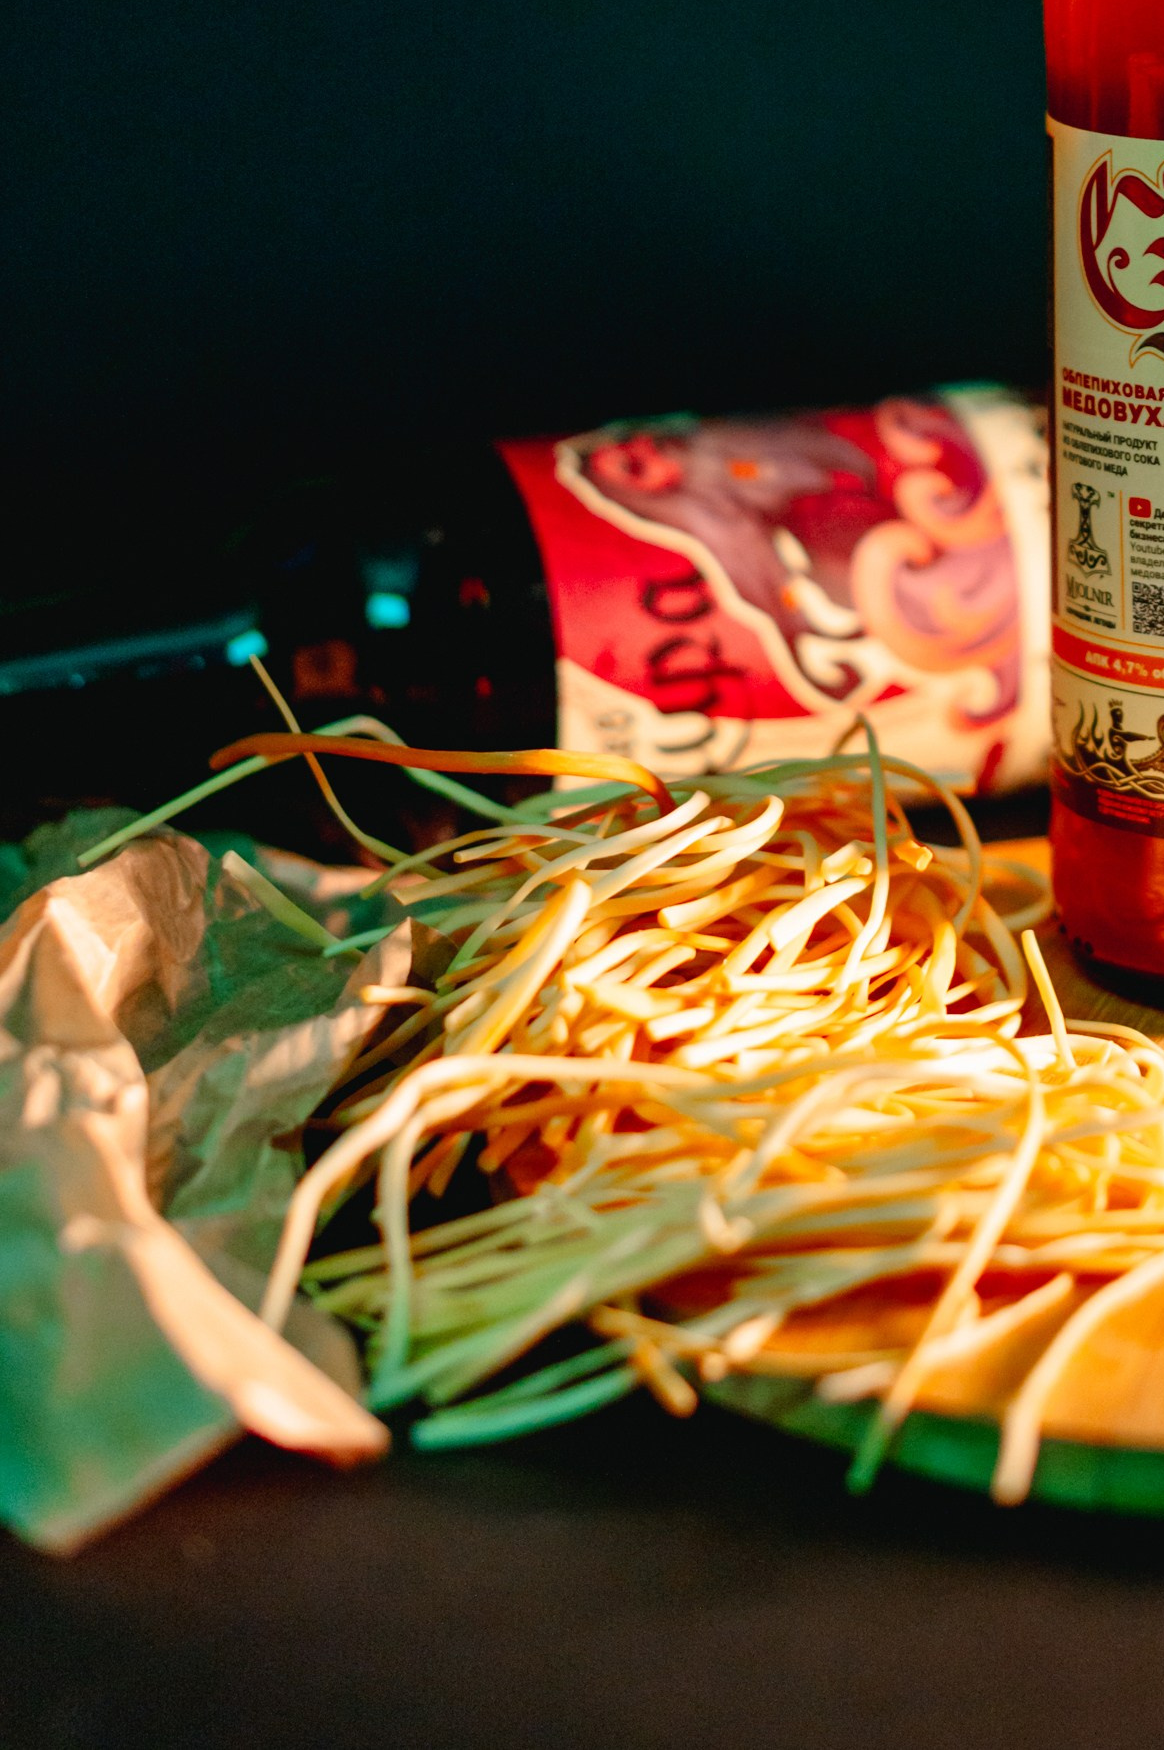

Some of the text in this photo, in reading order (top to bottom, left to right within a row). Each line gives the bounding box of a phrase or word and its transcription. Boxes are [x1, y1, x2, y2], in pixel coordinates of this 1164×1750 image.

[1113, 434, 1158, 451] ПРОДУКТ
[1133, 453, 1161, 466] СОКА
[1113, 658, 1148, 677] 4,7%
